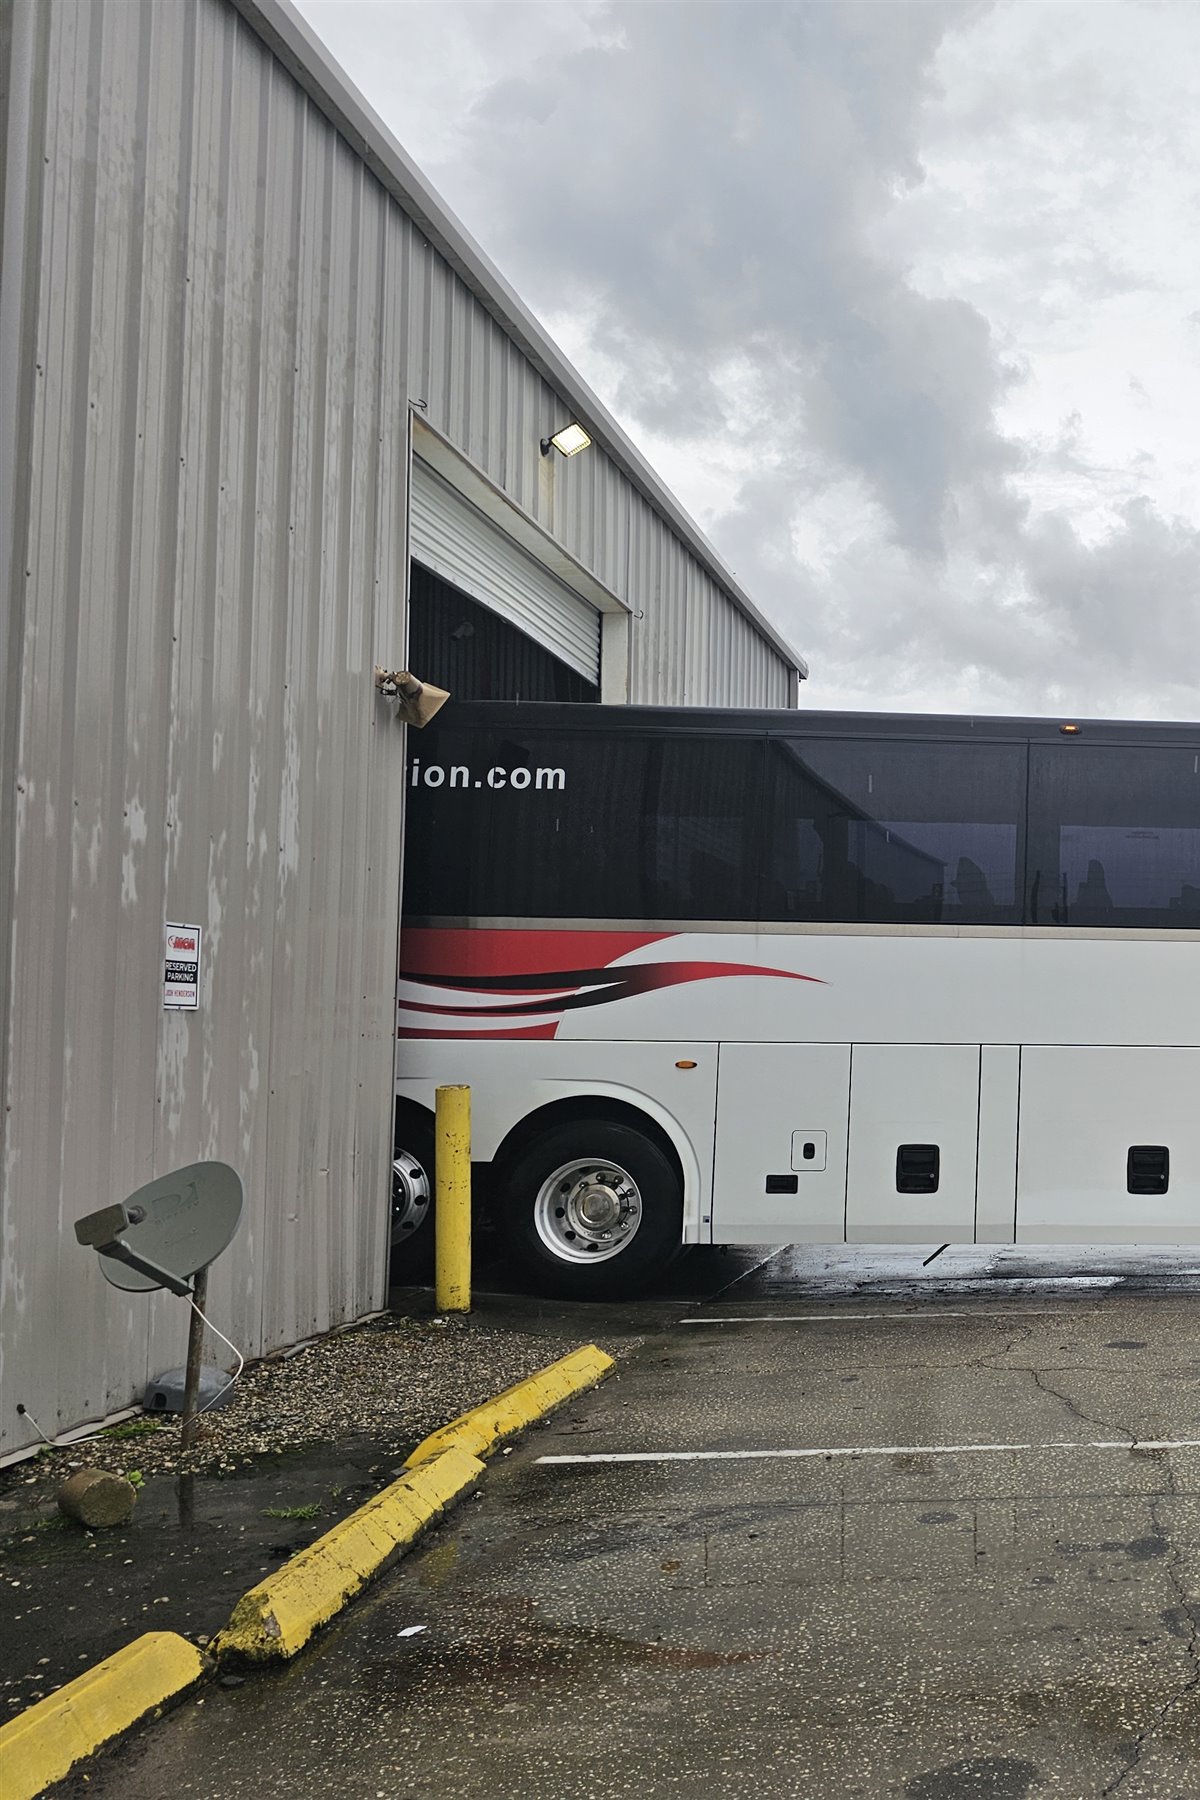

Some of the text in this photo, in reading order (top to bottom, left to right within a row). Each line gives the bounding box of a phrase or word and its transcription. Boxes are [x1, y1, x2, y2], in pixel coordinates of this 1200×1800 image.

[411, 758, 566, 790] ion.com
[165, 962, 197, 972] RESERVED
[167, 972, 194, 982] PARKING
